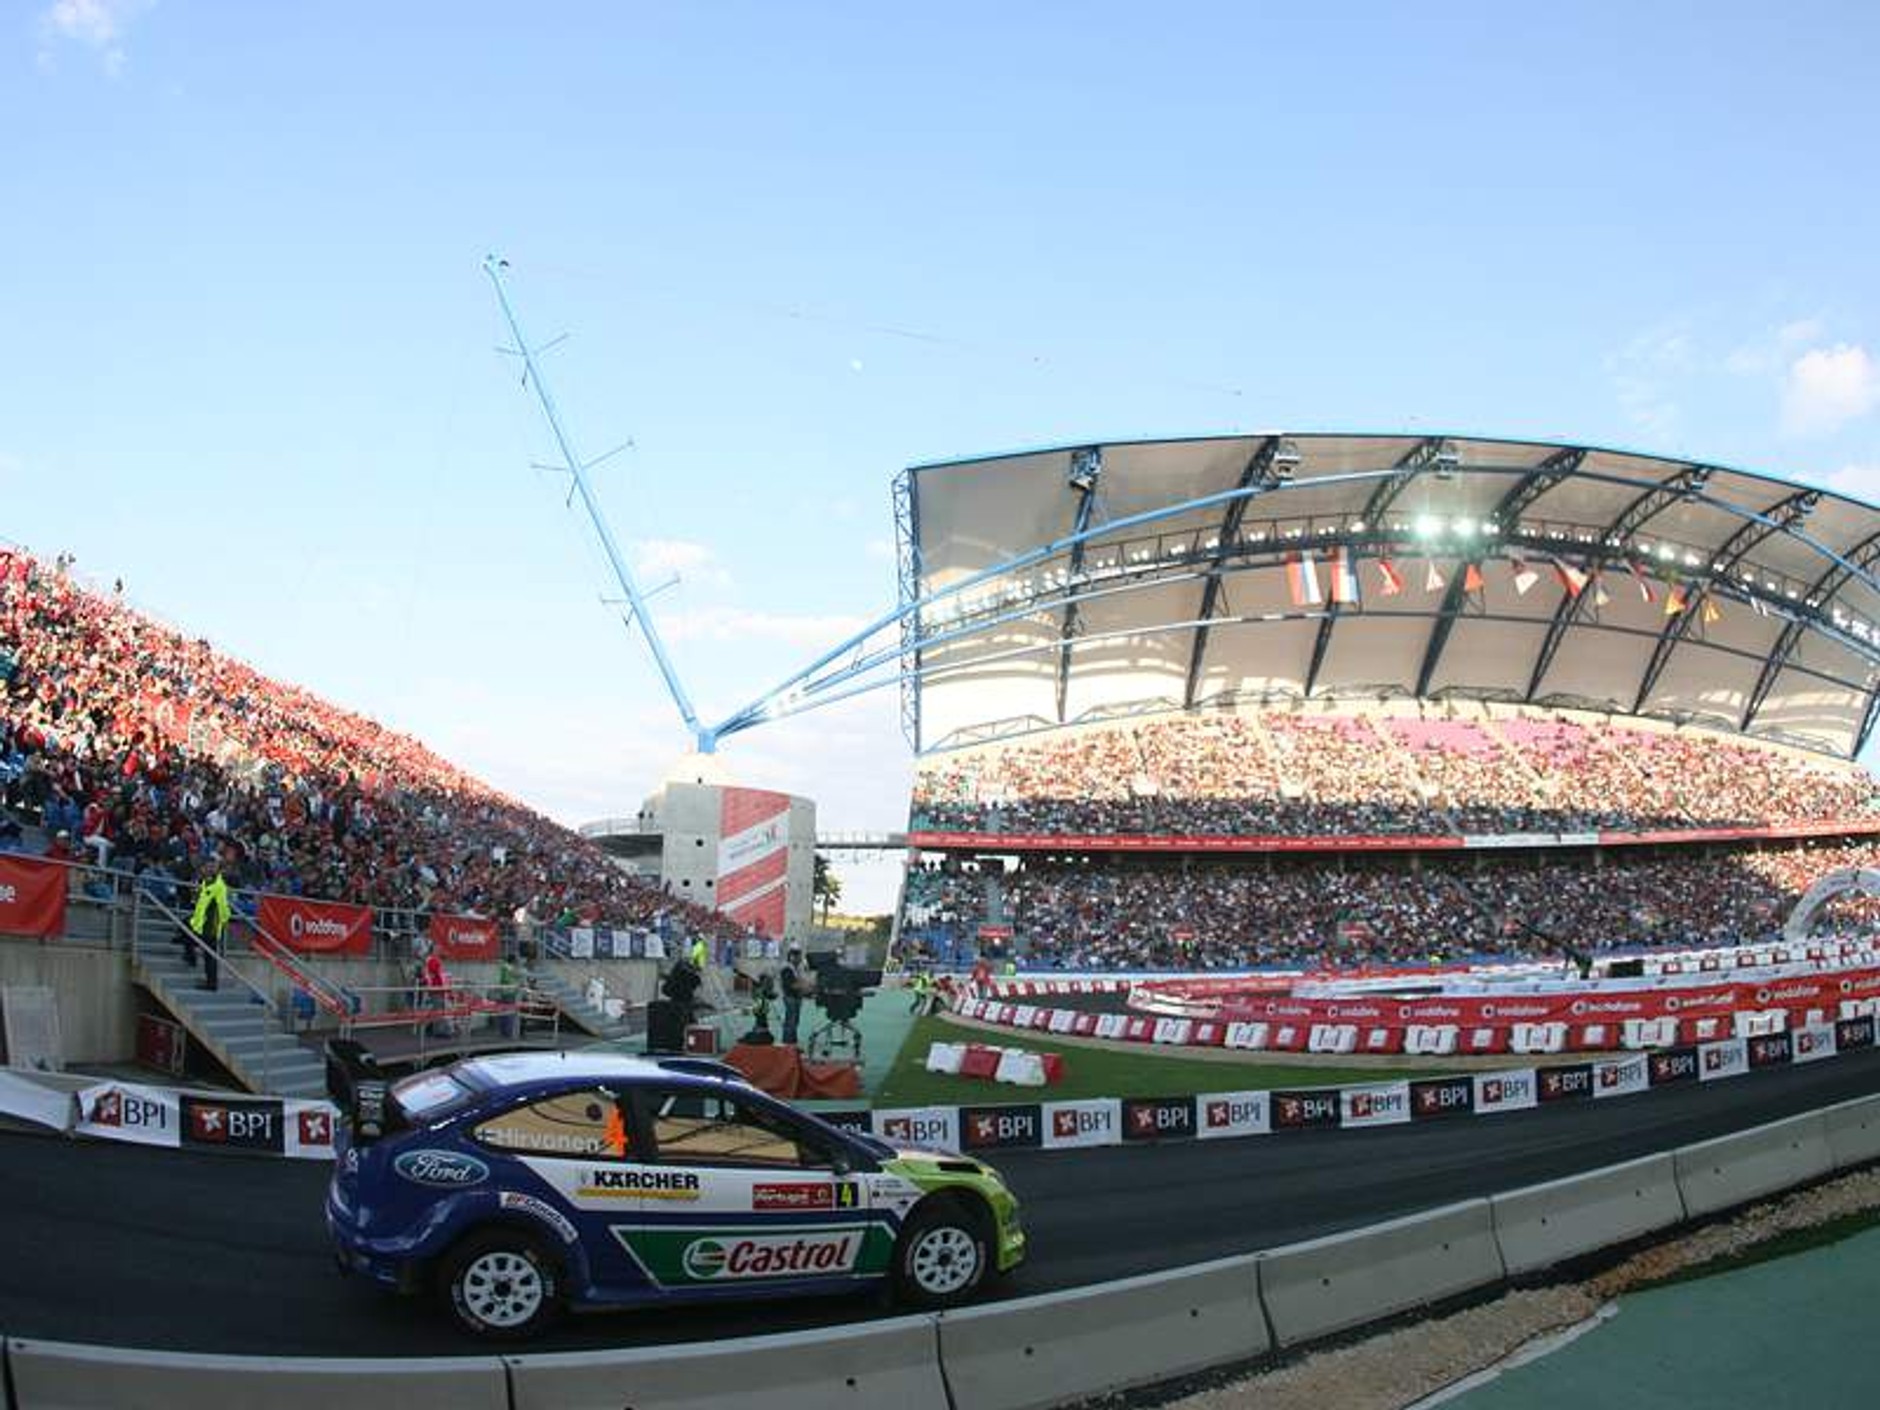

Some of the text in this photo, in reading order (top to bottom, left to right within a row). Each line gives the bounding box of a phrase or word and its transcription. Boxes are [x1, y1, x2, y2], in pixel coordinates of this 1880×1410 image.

[1672, 1056, 1694, 1075] BPI
[1503, 1080, 1529, 1099] BPI
[1562, 1072, 1588, 1091] BPI
[1374, 1093, 1401, 1112] BPI
[1440, 1086, 1468, 1106] BPI
[124, 1099, 166, 1128] BPI
[1157, 1106, 1189, 1129] BPI
[1230, 1102, 1260, 1123] BPI
[1303, 1099, 1334, 1119] BPI
[228, 1111, 272, 1139] BPI
[603, 1102, 627, 1157] 4
[912, 1119, 947, 1141] BPI
[998, 1116, 1033, 1139] BPI
[1079, 1110, 1111, 1131] BPI
[499, 1127, 599, 1151] Hirvonen
[410, 1151, 472, 1181] Ford
[594, 1170, 699, 1190] KÄRCHER
[841, 1183, 852, 1206] 4
[728, 1237, 850, 1273] Castrol
